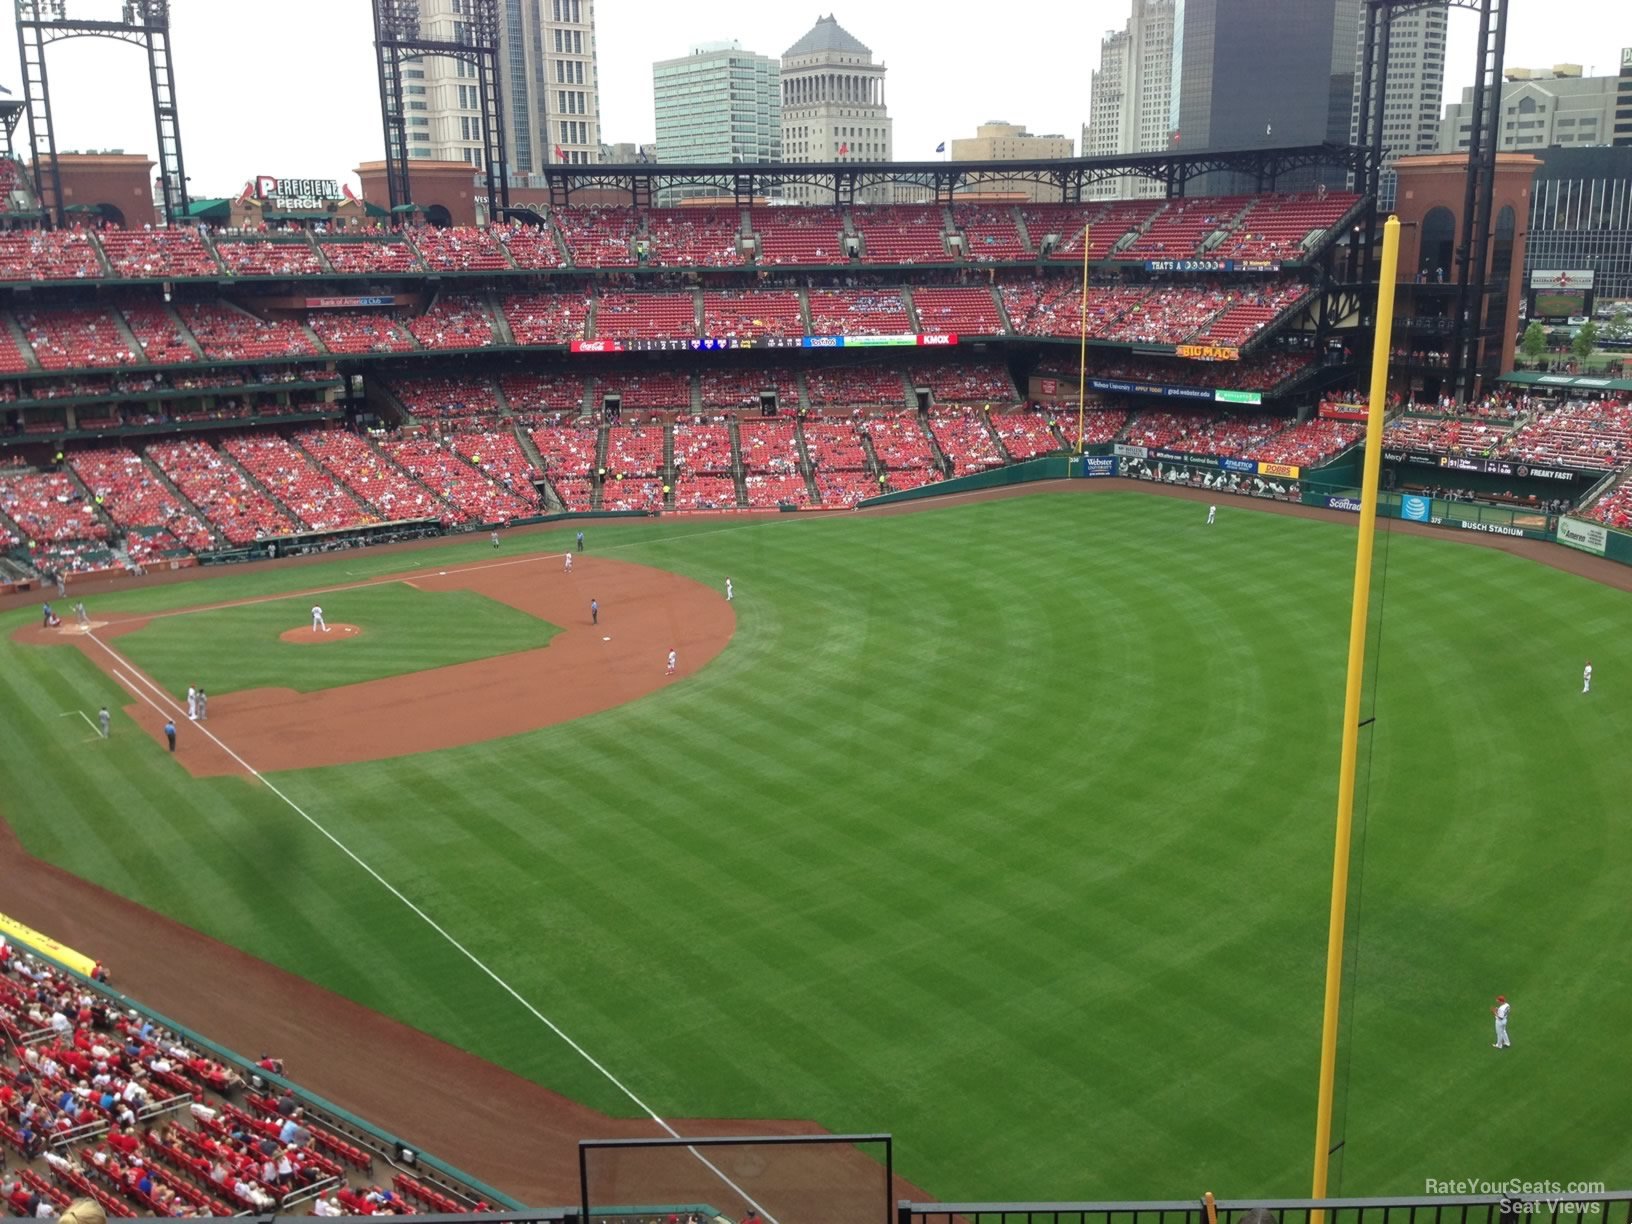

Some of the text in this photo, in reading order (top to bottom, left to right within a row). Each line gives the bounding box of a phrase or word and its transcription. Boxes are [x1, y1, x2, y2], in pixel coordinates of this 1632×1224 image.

[257, 176, 338, 199] PERFICIENT
[276, 199, 322, 209] PERCH
[1151, 261, 1174, 270] THAT'S
[1176, 261, 1181, 270] A
[924, 335, 949, 344] KMOX
[1183, 346, 1201, 357] BIG
[1203, 347, 1231, 359] MAC
[1087, 458, 1112, 466] Webster
[1189, 456, 1219, 466] Central Bank
[1384, 453, 1402, 462] Mercy
[1266, 465, 1291, 474] DOBBS
[1530, 469, 1573, 480] FREAKY FAST!
[1329, 498, 1362, 511] Scottrad
[1462, 520, 1524, 537] BUSCH STADIUM
[1565, 530, 1586, 543] Ameren
